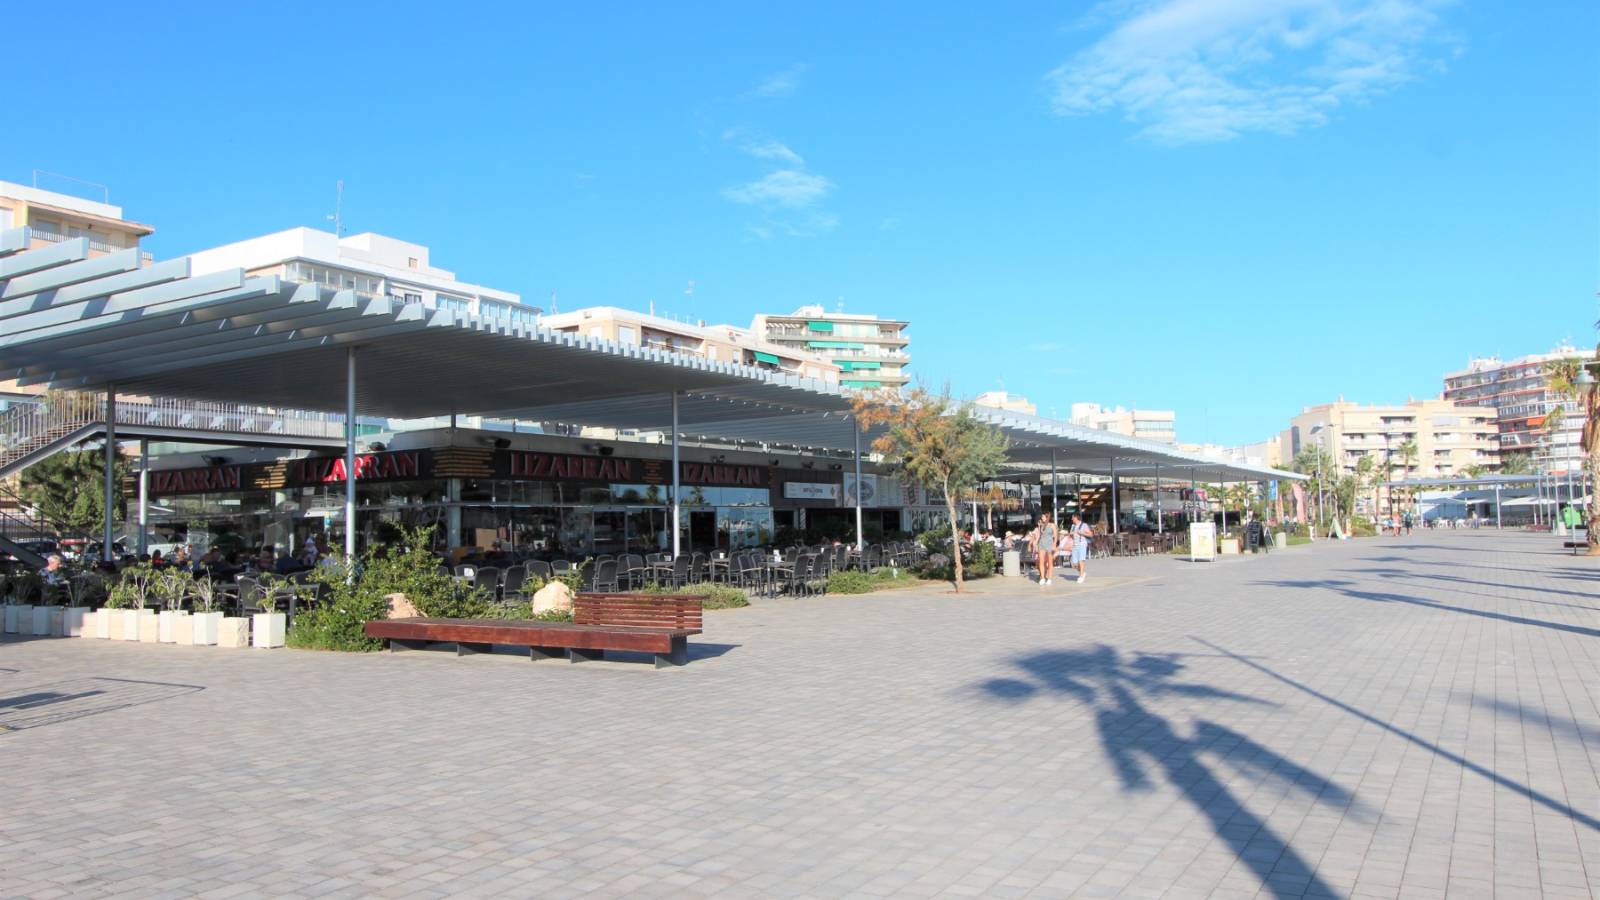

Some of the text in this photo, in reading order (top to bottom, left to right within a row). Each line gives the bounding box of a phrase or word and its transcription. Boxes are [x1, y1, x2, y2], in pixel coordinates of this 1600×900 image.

[295, 452, 419, 484] LIZARRAN
[510, 451, 633, 481] LIZARRAN
[681, 463, 761, 486] IZARRAN
